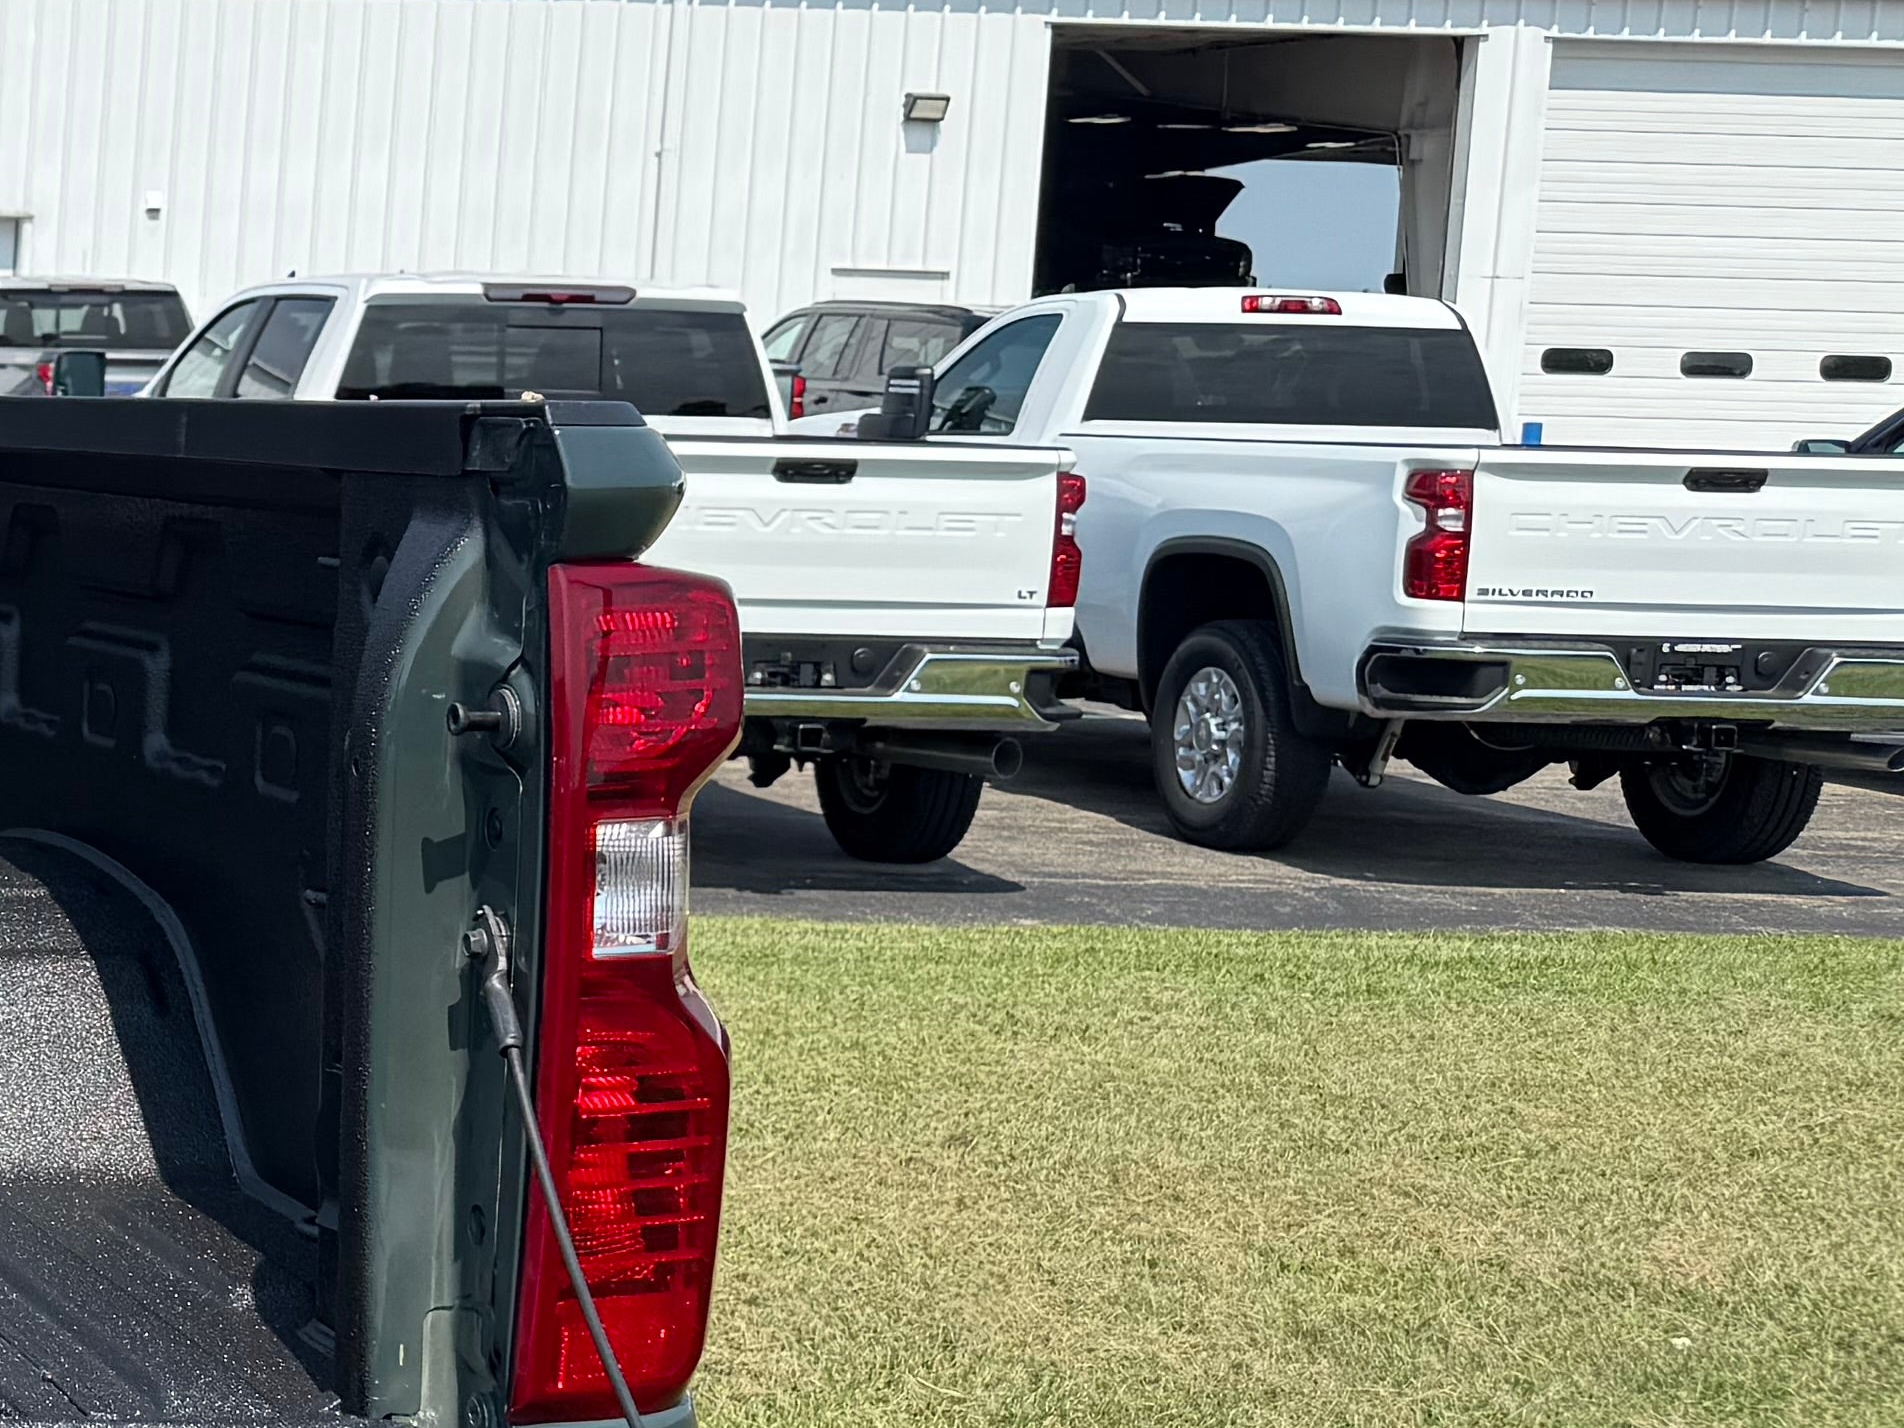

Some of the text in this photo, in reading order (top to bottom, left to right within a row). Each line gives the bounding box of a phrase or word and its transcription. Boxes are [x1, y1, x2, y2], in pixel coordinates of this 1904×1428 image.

[676, 506, 1024, 538] EVROLET
[1017, 589, 1038, 600] LT
[1476, 587, 1594, 599] SILVERADO
